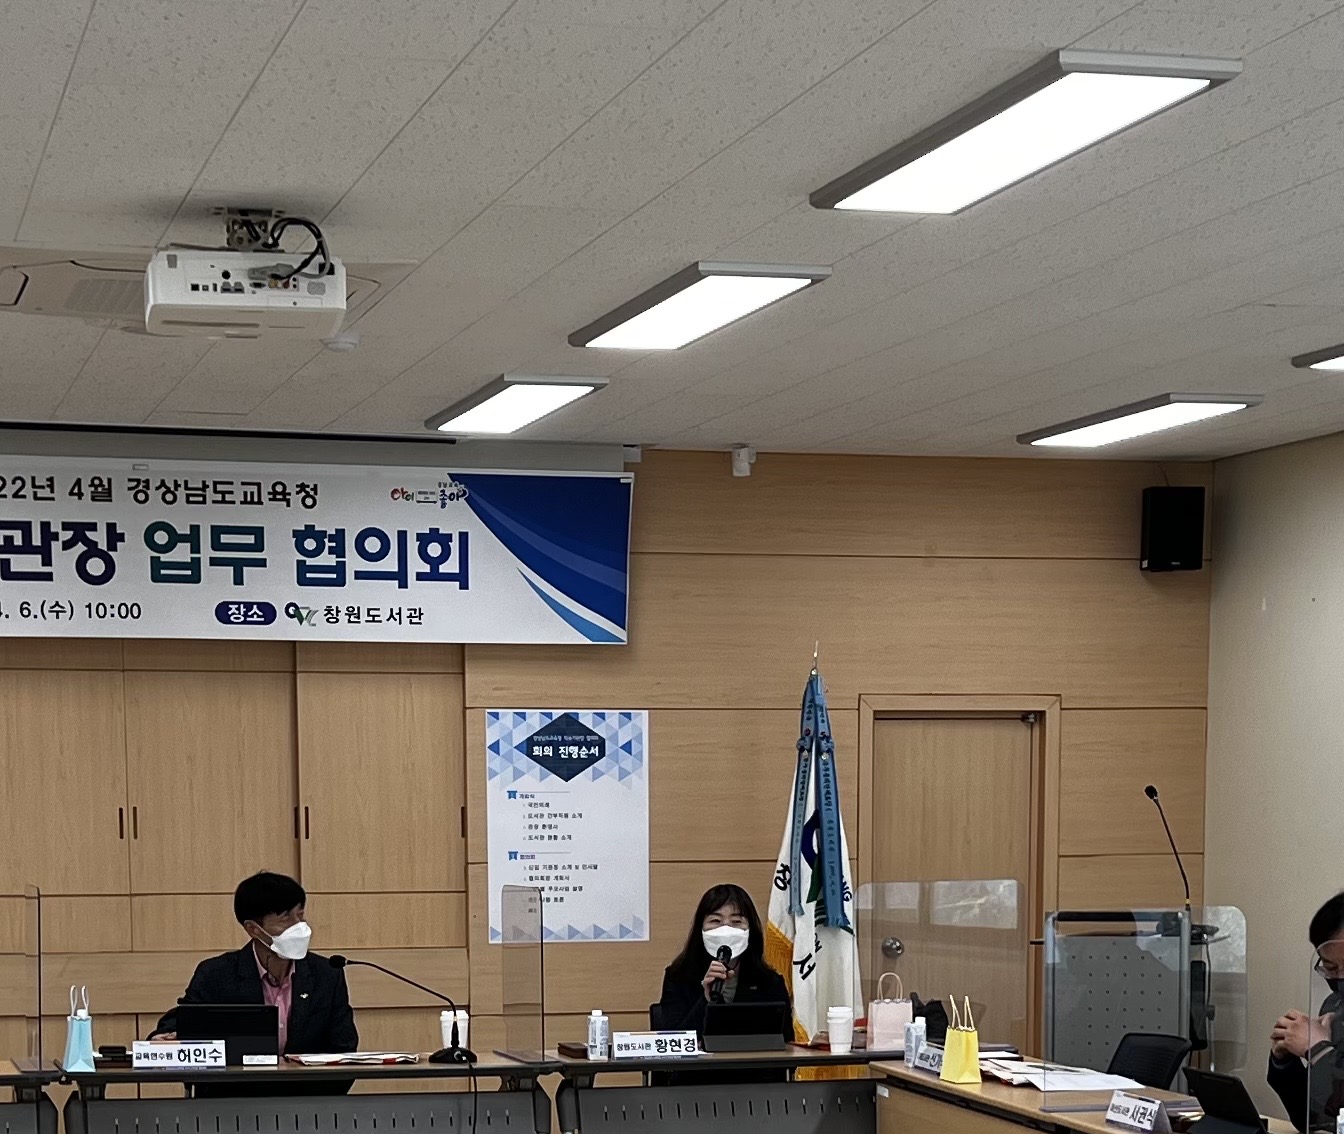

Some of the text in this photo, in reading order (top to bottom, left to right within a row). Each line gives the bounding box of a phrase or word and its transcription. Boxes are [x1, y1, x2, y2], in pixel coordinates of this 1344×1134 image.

[68, 477, 114, 503] 4월
[126, 477, 319, 509] 경상남도교육청
[143, 520, 268, 587] 업무
[292, 524, 470, 590] 협의회
[20, 600, 74, 622] 6.(수)
[85, 602, 142, 621] 10:00
[227, 603, 265, 622] 장소
[323, 605, 425, 625] 창원도서관
[533, 745, 599, 758] 회의 진행순서
[177, 1048, 223, 1063] 허인수
[655, 1038, 696, 1054] 황현경
